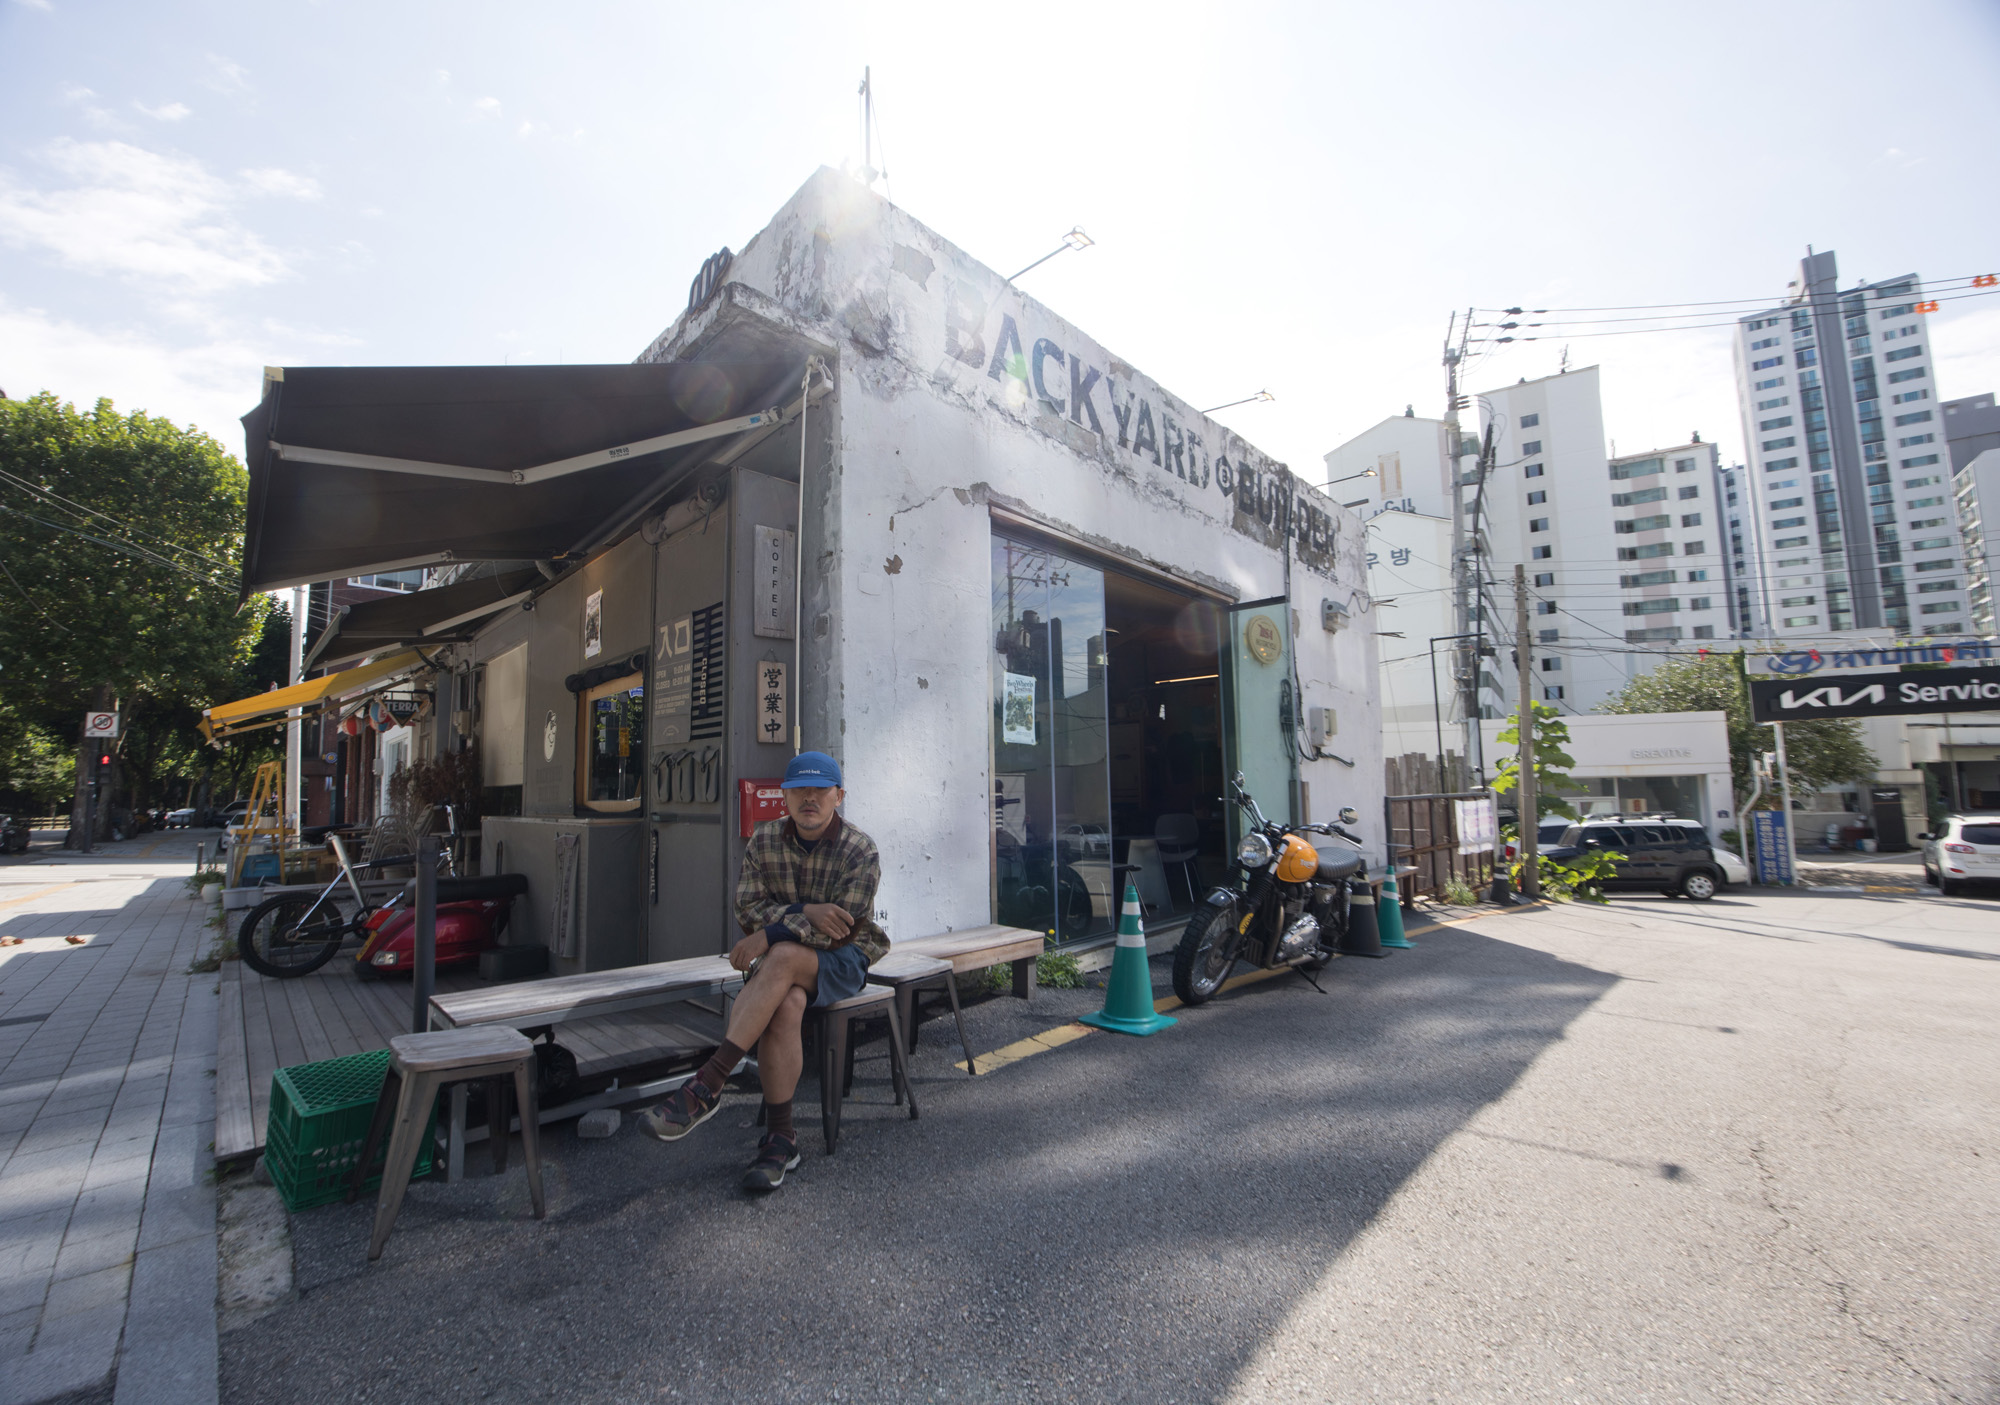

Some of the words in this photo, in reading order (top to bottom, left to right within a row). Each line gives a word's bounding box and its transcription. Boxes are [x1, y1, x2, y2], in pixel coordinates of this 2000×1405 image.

[944, 277, 1210, 489] BACKYARD
[771, 538, 779, 617] COFFEE
[657, 618, 691, 661] 入口
[655, 670, 666, 679] OPEN
[684, 663, 691, 672] AM
[655, 680, 670, 690] CLOSED
[699, 657, 708, 705] CLOSED
[385, 701, 420, 712] TERRA
[1779, 684, 1886, 710] KIA
